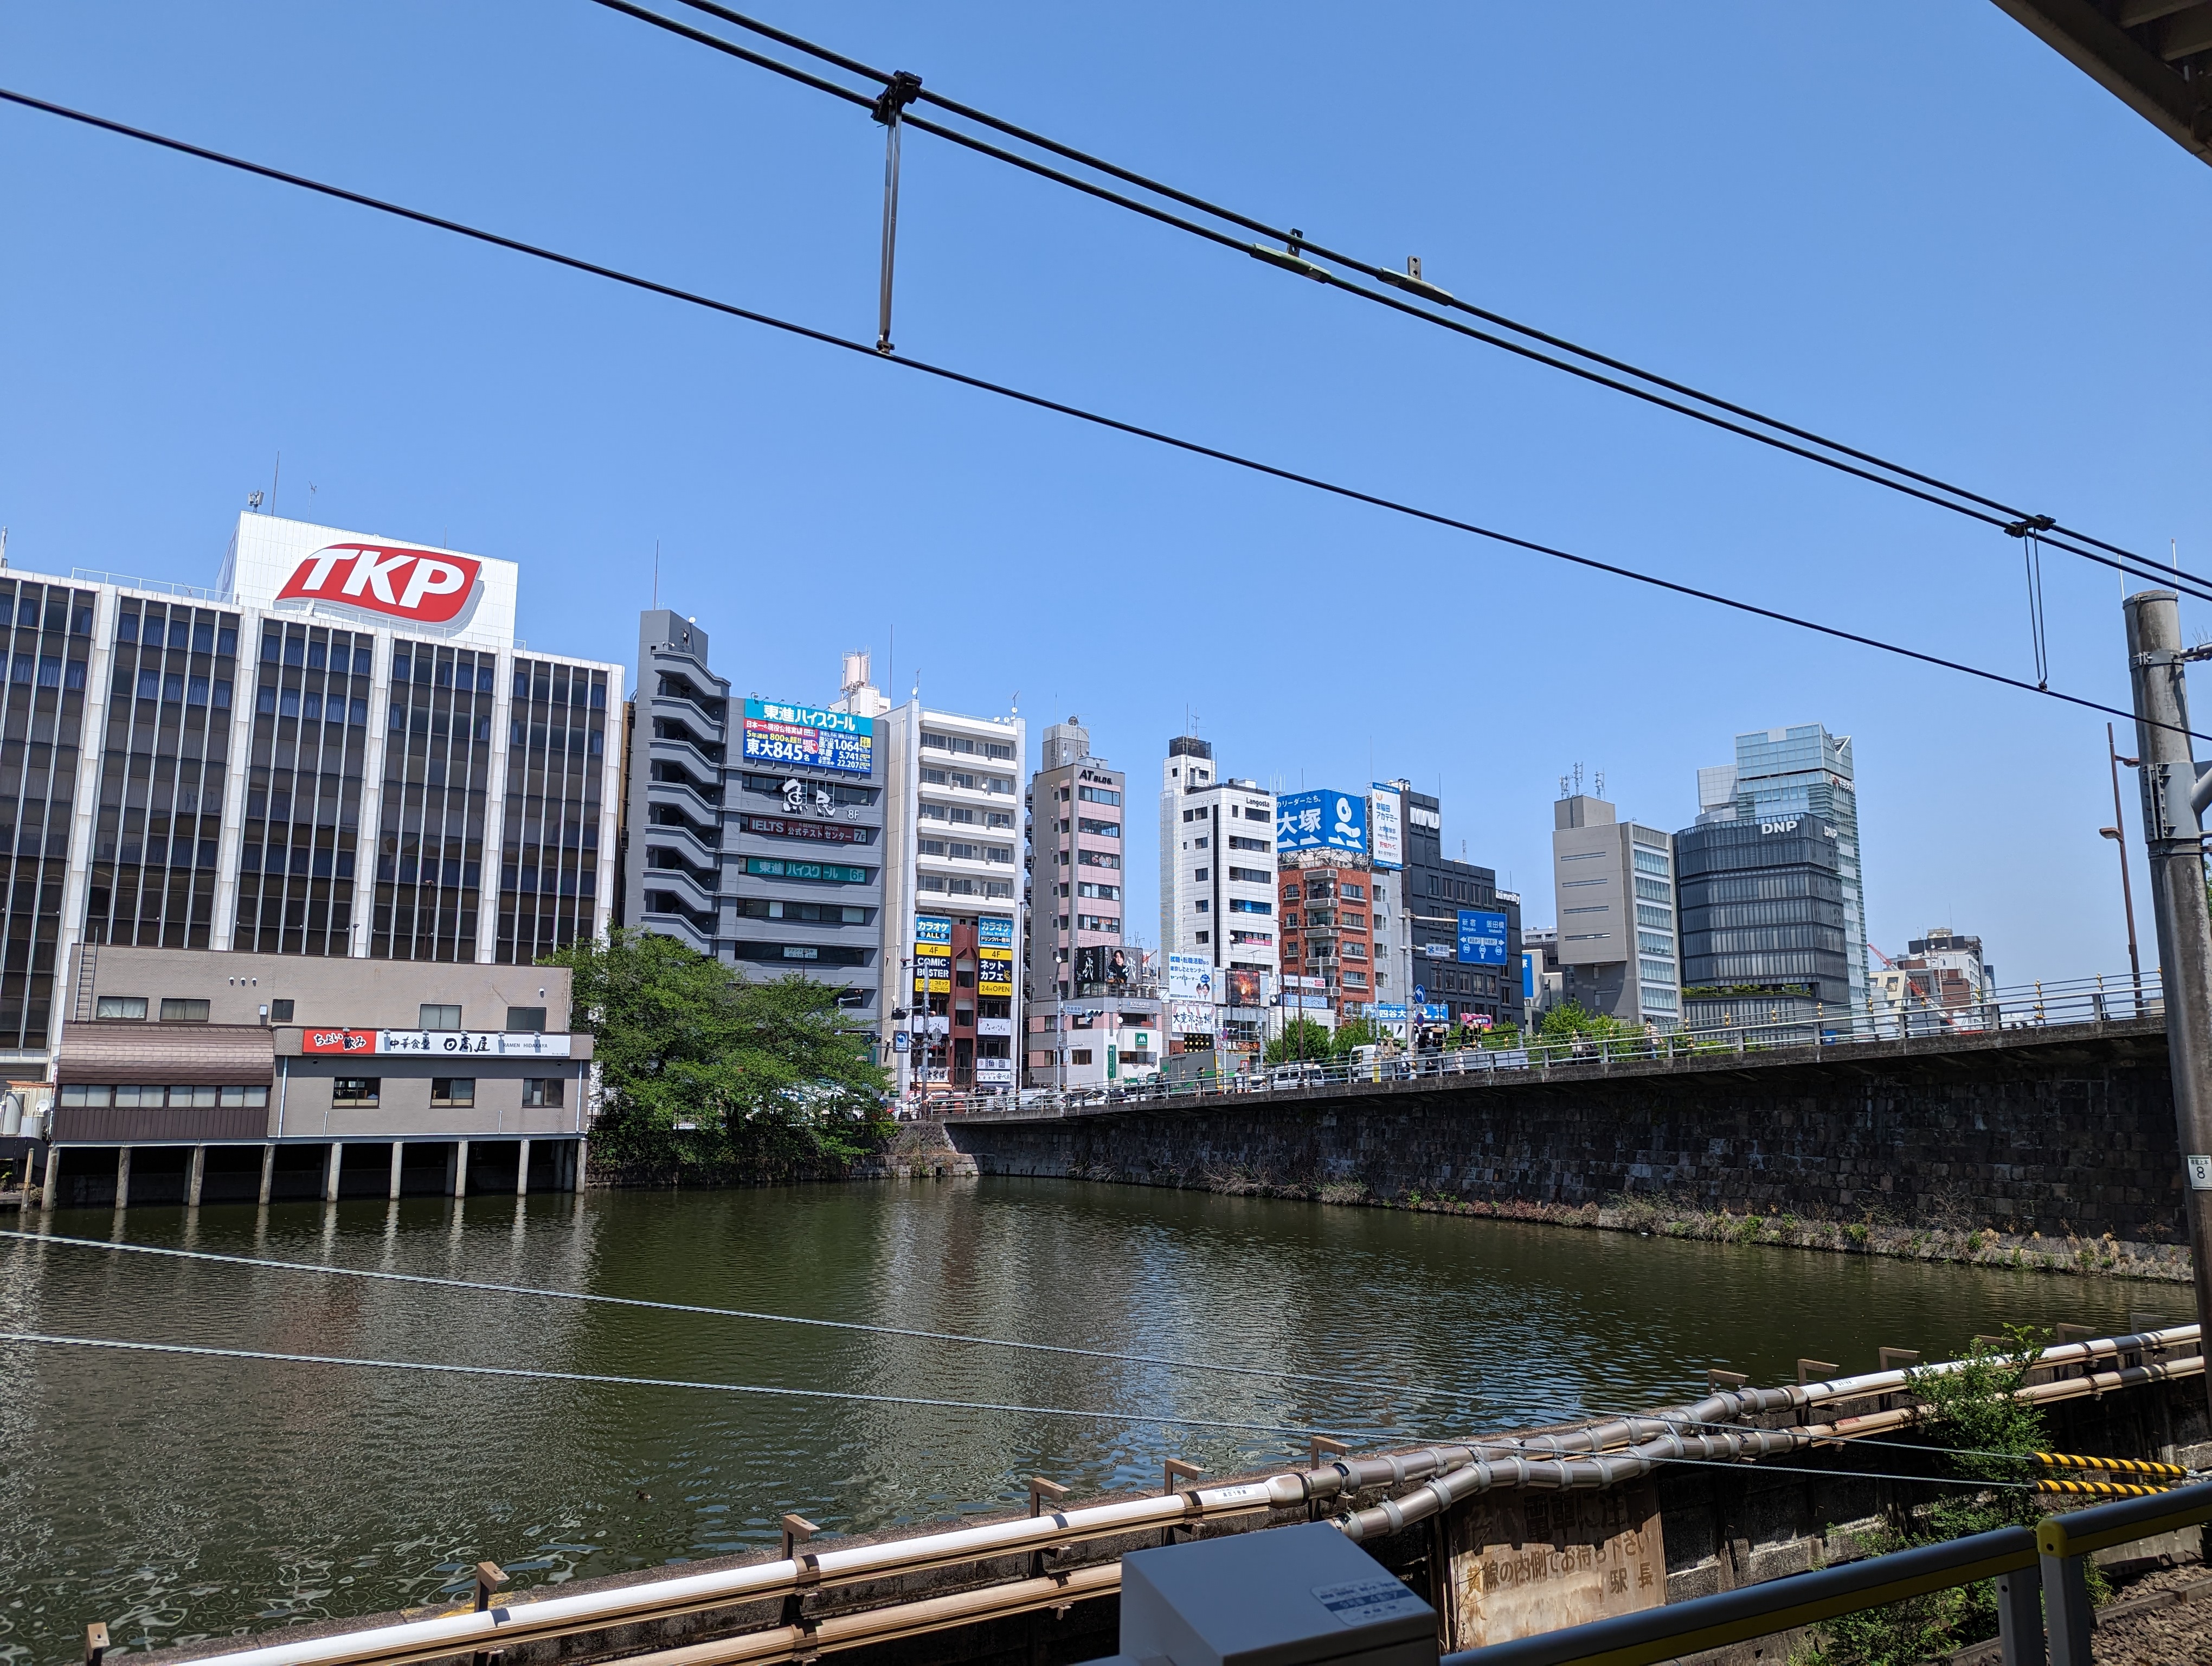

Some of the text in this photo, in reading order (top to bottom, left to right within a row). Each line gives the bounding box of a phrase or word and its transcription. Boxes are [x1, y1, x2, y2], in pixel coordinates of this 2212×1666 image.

[300, 548, 465, 608] TKP
[763, 704, 856, 732] 東進ハイスクール
[746, 720, 803, 735] 日本一の現役合格実績
[834, 739, 859, 752] 1,064
[839, 751, 859, 761] 5,741
[837, 759, 859, 769] 22,207
[1079, 770, 1113, 785] AT BLDG.
[782, 779, 836, 816] 魚民
[1246, 797, 1270, 808] Langosta
[847, 809, 860, 819] 8F
[1376, 803, 1391, 813] 早稲田
[1376, 811, 1398, 822] アカデミー
[1410, 806, 1439, 829] MAU
[752, 819, 784, 833] IELTS
[1762, 821, 1797, 835] DNP
[1824, 826, 1837, 839] DNP
[787, 826, 865, 841] 公式テストセンター 7F
[759, 861, 864, 880] 東進ハイスクール 6F
[918, 921, 1011, 932] カラオケ カラオケ
[980, 960, 1004, 971] ネット
[980, 971, 1004, 981] カフェ
[313, 1033, 367, 1050] ちょい飲み
[390, 1035, 430, 1050] 中華食堂
[443, 1036, 490, 1053] 日高屋
[2196, 1166, 2205, 1179] 8
[1610, 1562, 1653, 1594] 駅長
